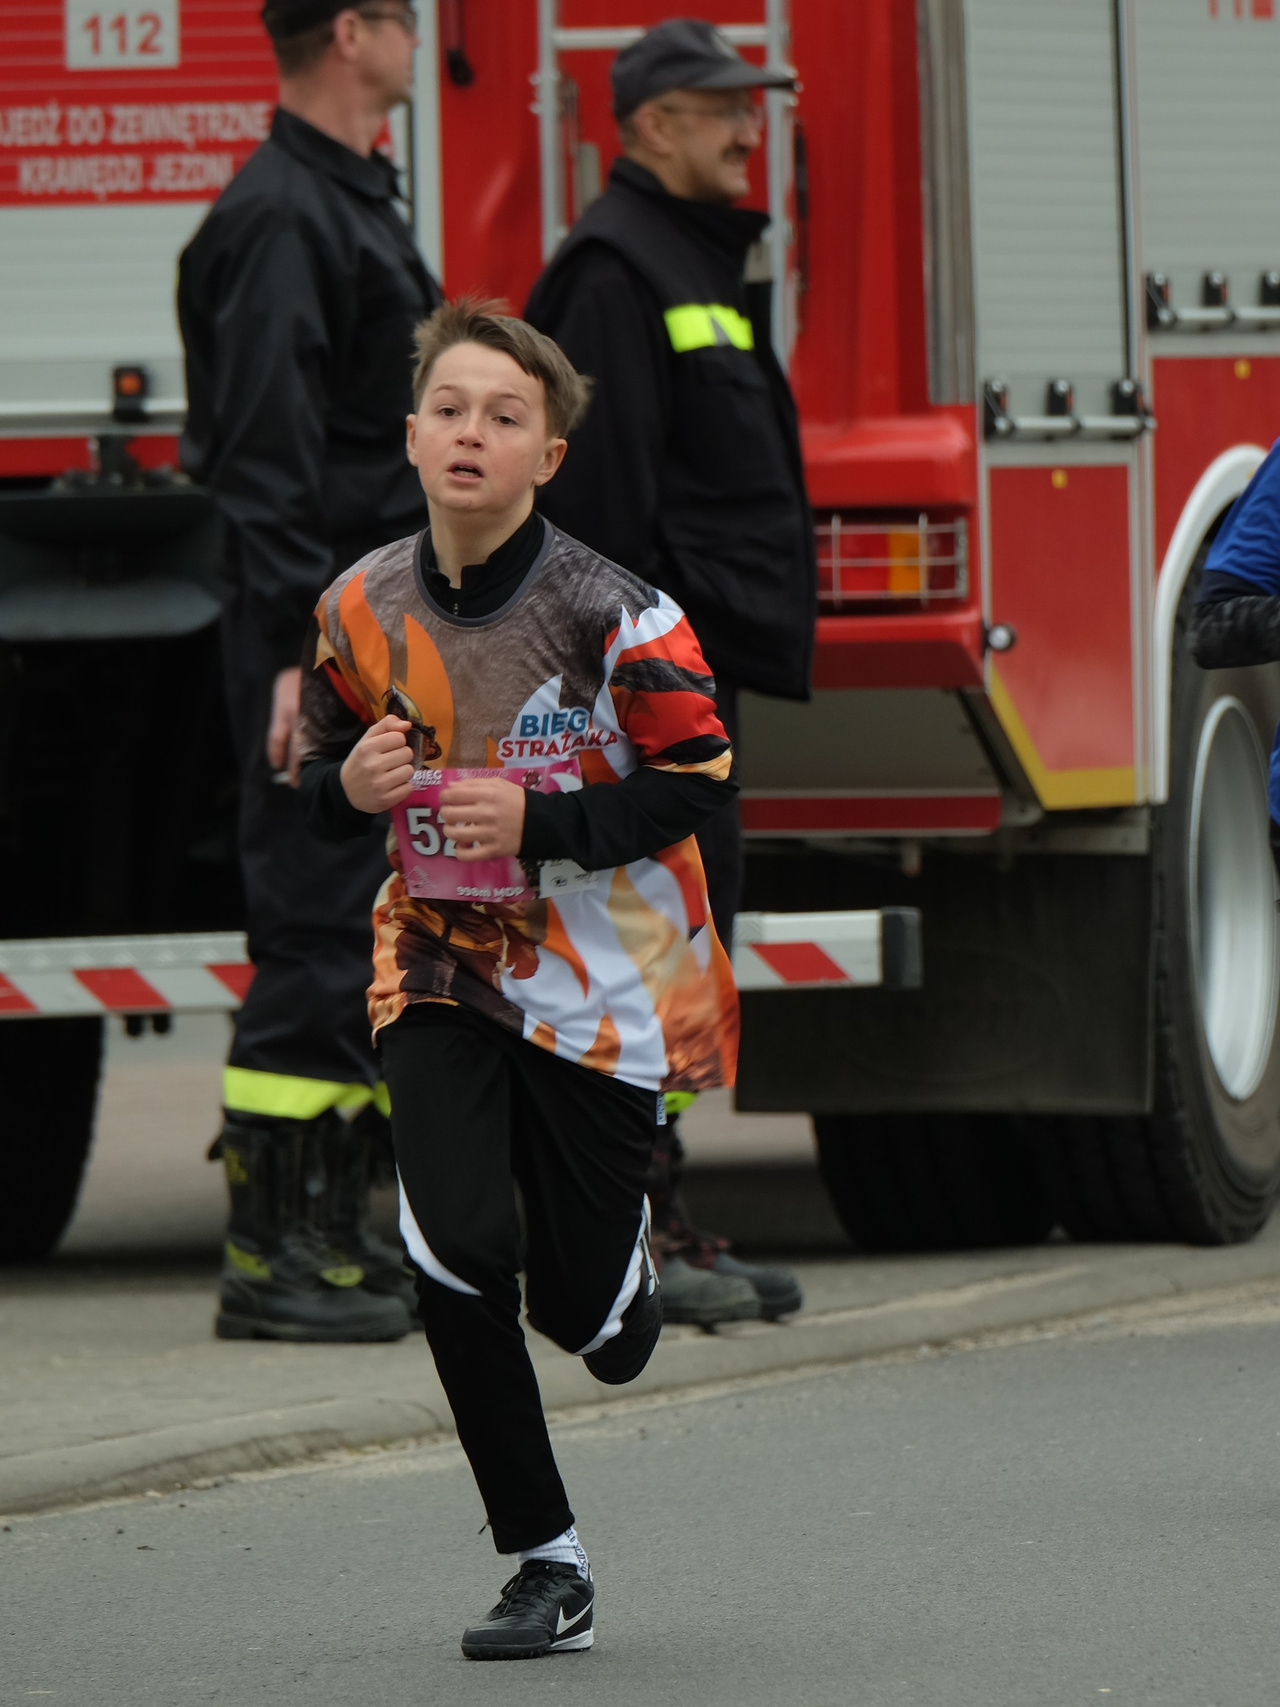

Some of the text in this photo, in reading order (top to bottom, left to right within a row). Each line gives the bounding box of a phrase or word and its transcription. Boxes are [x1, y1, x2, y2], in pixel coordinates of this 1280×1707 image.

[84, 13, 162, 55] 112
[67, 105, 104, 144] DO
[520, 709, 588, 738] BIEG
[500, 729, 619, 758] STRAŻAKA
